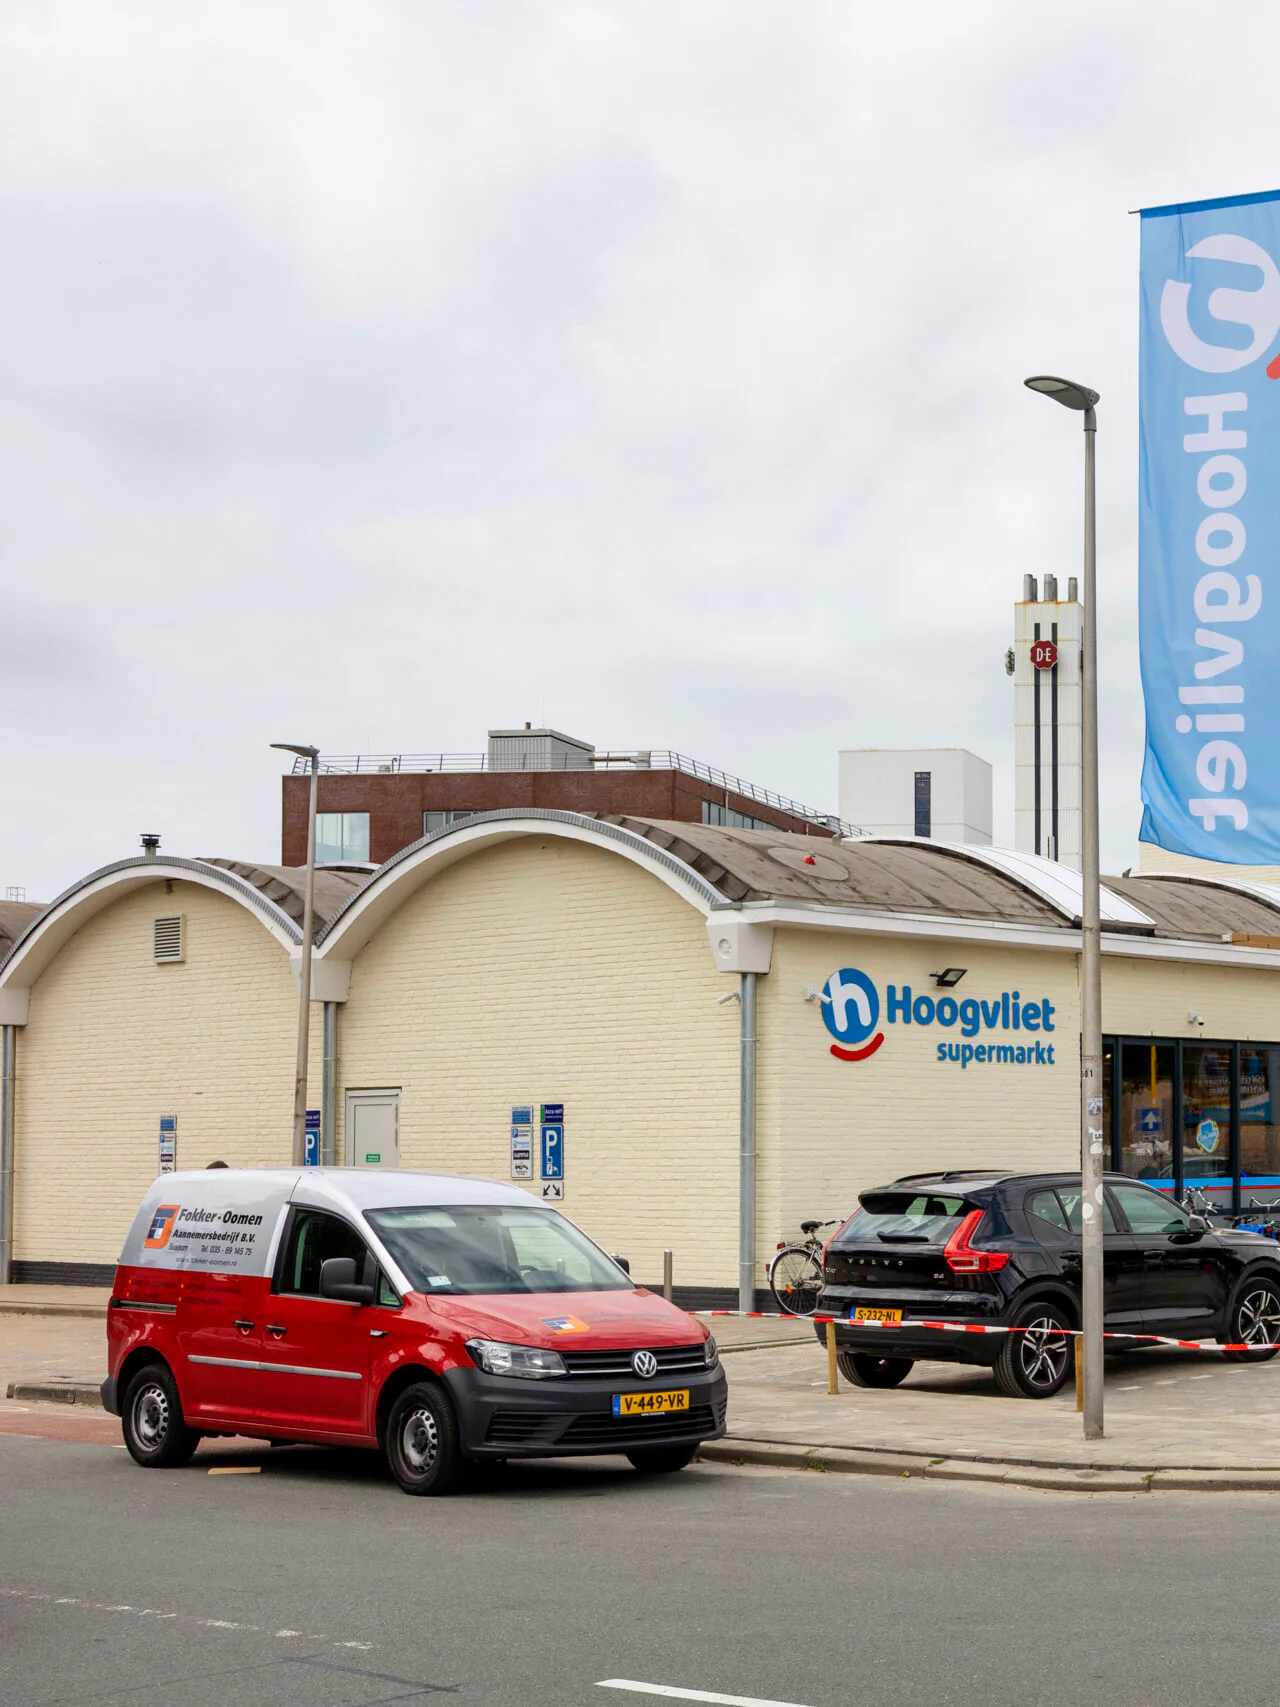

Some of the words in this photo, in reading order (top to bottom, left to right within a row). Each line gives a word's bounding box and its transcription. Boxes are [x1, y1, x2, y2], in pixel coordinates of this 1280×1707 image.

[886, 984, 1056, 1037] Hoogvliet
[937, 1040, 1055, 1069] supermarkt
[179, 1208, 217, 1223] Fokker
[222, 1211, 263, 1225] Oomen
[172, 1229, 239, 1243] Aannemersbedrijf
[240, 1233, 256, 1243] B.V.
[209, 1245, 221, 1254] 035
[847, 1258, 904, 1266] VOLVO
[857, 1309, 898, 1321] S-232-NL
[624, 1393, 685, 1412] V-449-VR
